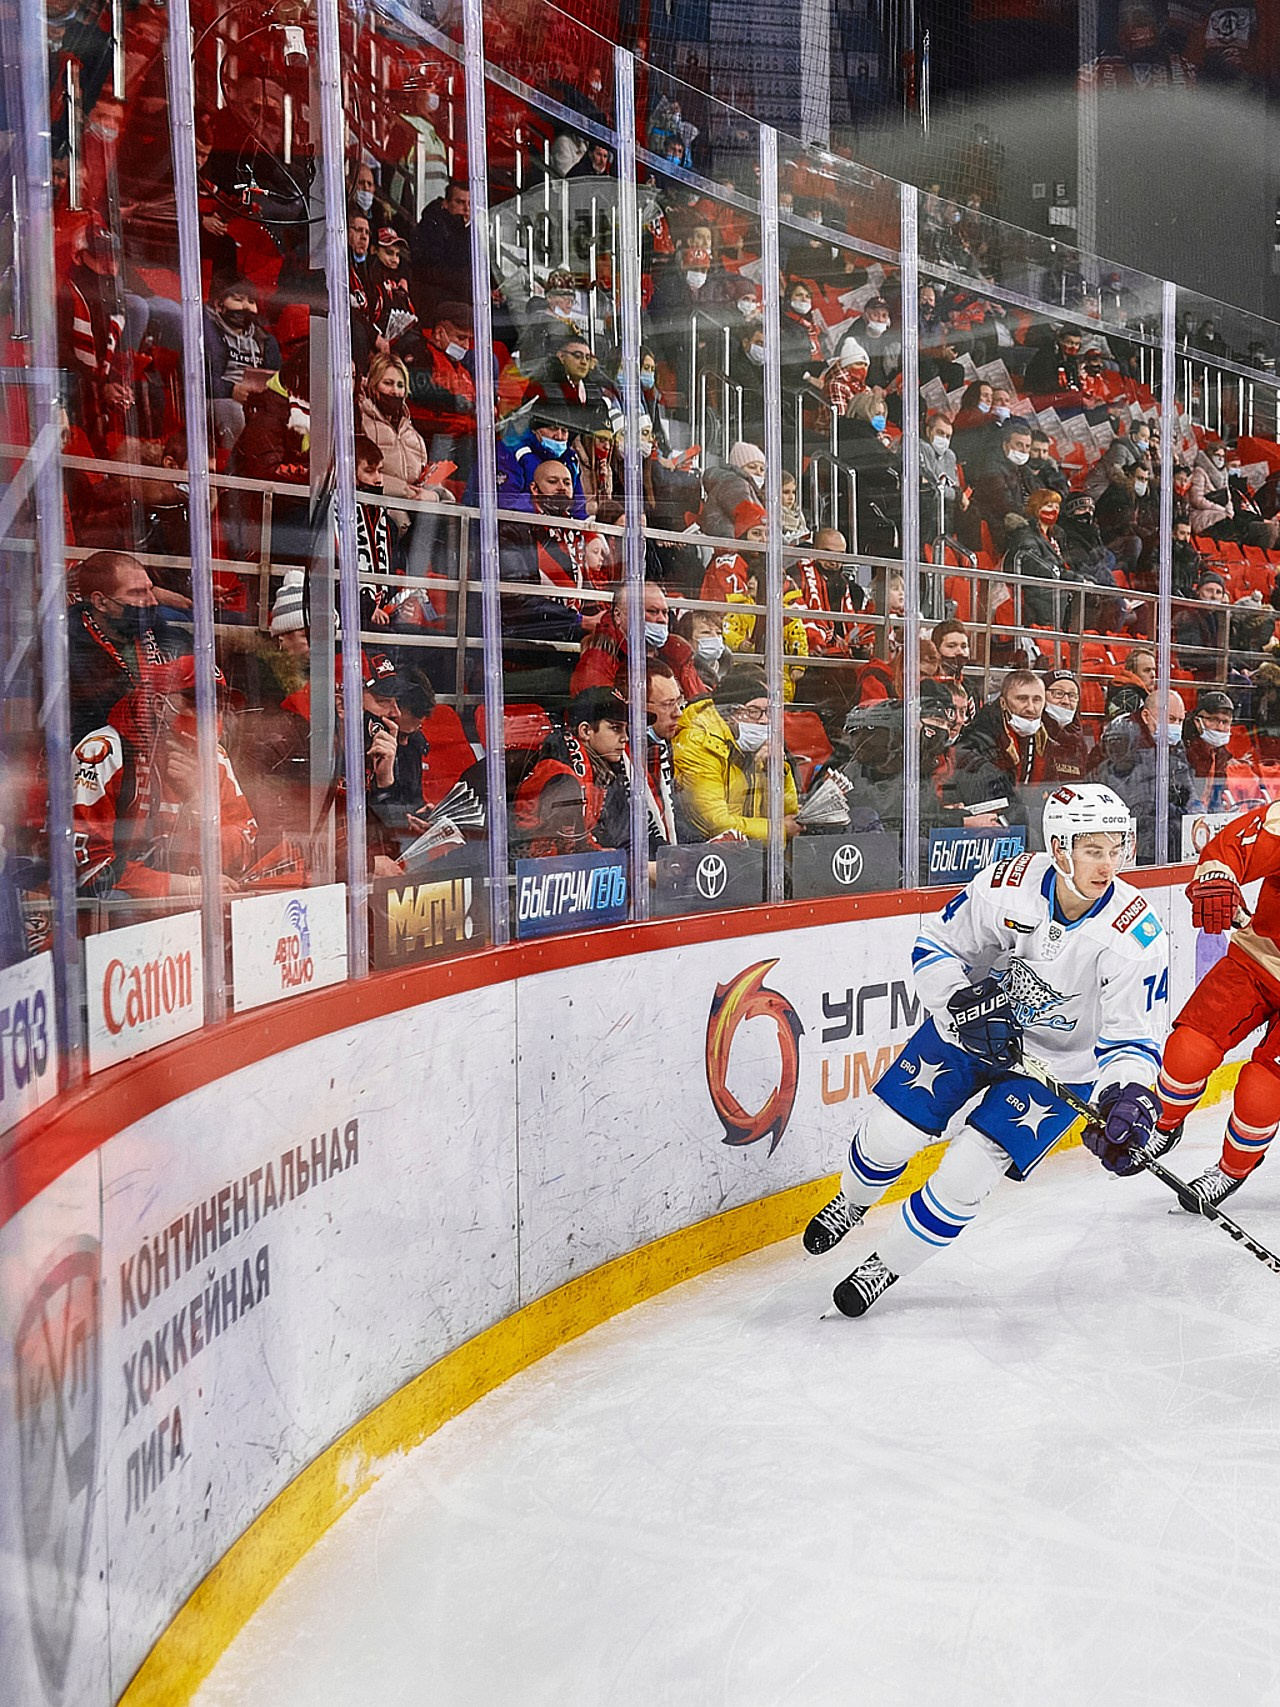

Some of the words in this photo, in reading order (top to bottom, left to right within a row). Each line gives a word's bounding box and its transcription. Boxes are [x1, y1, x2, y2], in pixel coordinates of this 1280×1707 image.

[1116, 897, 1146, 931] FONBET
[273, 935, 300, 965] АВТО
[280, 955, 315, 989] РАДИО
[102, 949, 193, 1035] Canon
[1142, 966, 1168, 1012] 14
[119, 1117, 360, 1330] КОНТИНЕНТАЛЬНАЯ
[121, 1243, 271, 1428] ХОККЕЙНАЯ
[124, 1404, 186, 1527] ЛИГА
